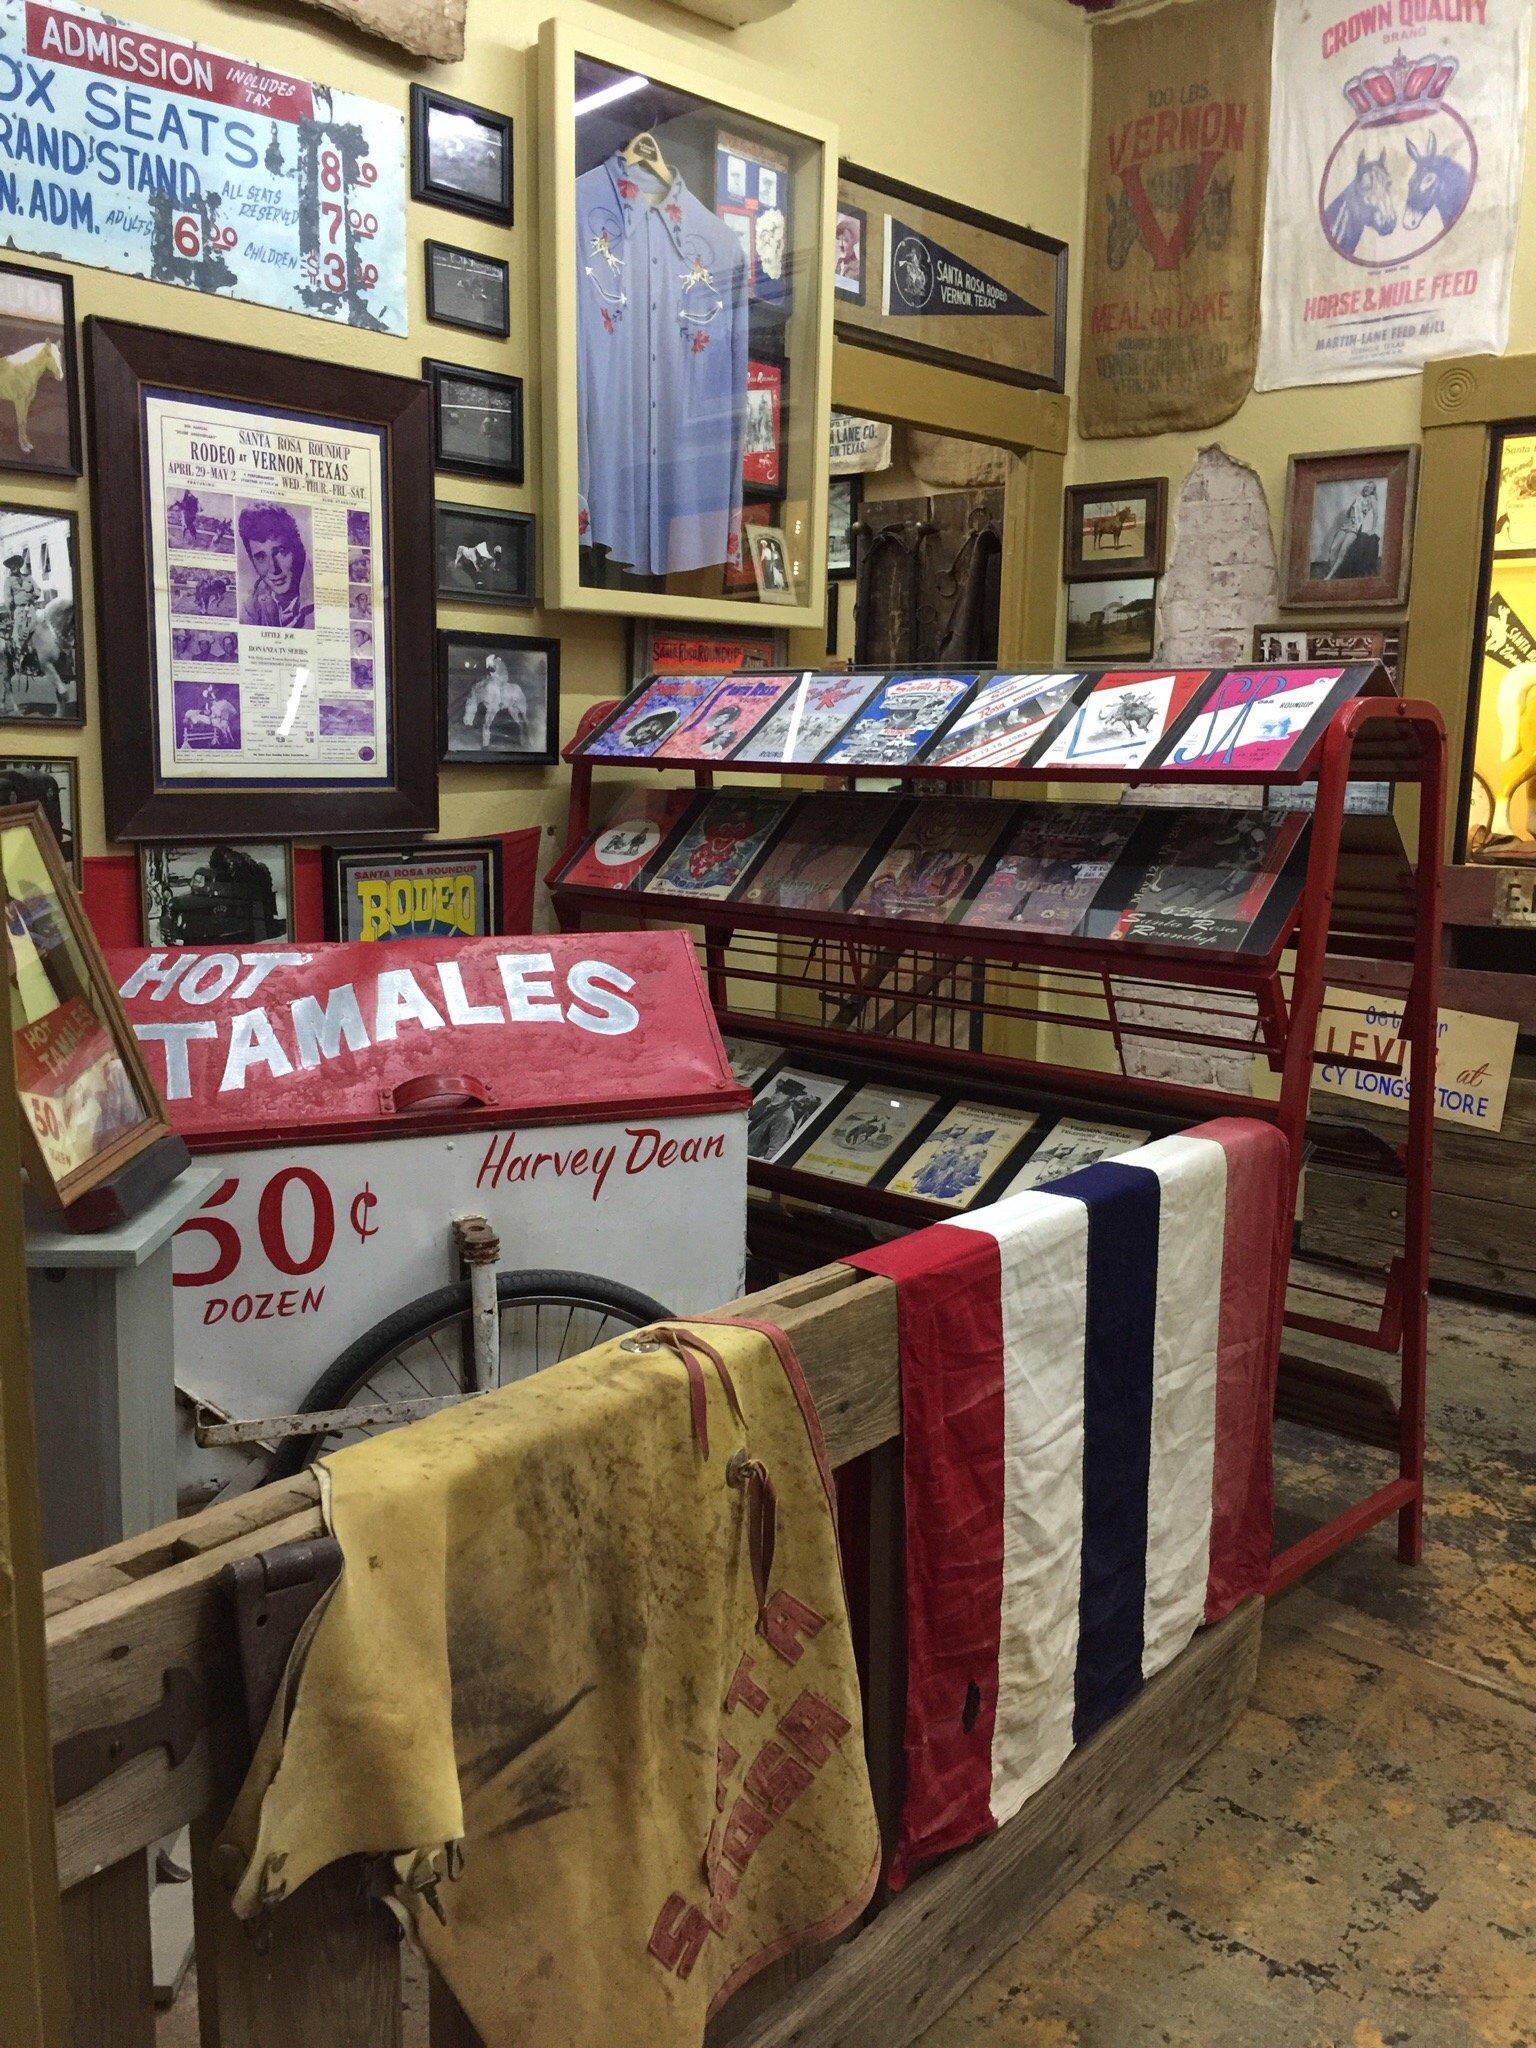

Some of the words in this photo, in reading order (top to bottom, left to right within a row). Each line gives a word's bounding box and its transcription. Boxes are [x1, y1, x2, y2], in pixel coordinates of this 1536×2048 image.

[1322, 1, 1392, 60] CROWN
[1400, 0, 1488, 27] QUALITY
[1382, 27, 1427, 45] BRAND
[42, 16, 214, 92] ADMISSION
[225, 67, 297, 98] INCLUDES
[245, 90, 273, 110] TAX
[84, 81, 259, 169] SEATS
[1108, 102, 1249, 174] VERNON
[28, 179, 101, 235] ADM.
[106, 209, 155, 238] ADULTS
[238, 203, 301, 228] RESERVED
[222, 181, 244, 202] ALL
[247, 184, 283, 206] SEATS
[243, 242, 298, 271] CHILDREN
[937, 259, 964, 288] SANTA
[965, 273, 986, 295] ROSA
[974, 293, 998, 310] TEXAS
[1303, 290, 1361, 323] HORSE
[1362, 287, 1378, 312] &
[1378, 278, 1426, 311] MULE
[1430, 269, 1479, 301] FEED
[1391, 325, 1416, 341] FEED
[1419, 320, 1446, 336] MILL
[238, 430, 271, 449] SANTA
[277, 436, 302, 454] ROSA
[308, 442, 351, 462] ROUNDUP
[836, 426, 862, 444] LANE
[863, 424, 878, 440] CO.
[168, 462, 195, 477] APRIL
[190, 441, 236, 466] RODEO
[238, 454, 248, 463] AT
[309, 459, 350, 483] TEXAS
[353, 870, 392, 881] SANTA
[394, 868, 424, 879] ROSA
[426, 864, 478, 876] ROUNDUP
[357, 876, 478, 942] RODEO
[1120, 913, 1184, 928] Santa
[1187, 919, 1239, 934] Rosa
[1160, 905, 1216, 920] 65th
[1128, 924, 1219, 946] Roundup
[119, 951, 310, 1005] HOT
[24, 1019, 51, 1051] HOT
[133, 952, 641, 1102] TAMALES
[1321, 1063, 1349, 1086] CY
[1435, 1086, 1490, 1118] TORE
[1456, 1062, 1493, 1088] at
[476, 1131, 616, 1202] Harvey
[625, 1127, 726, 1177] Dean
[203, 1286, 326, 1326] DOZEN
